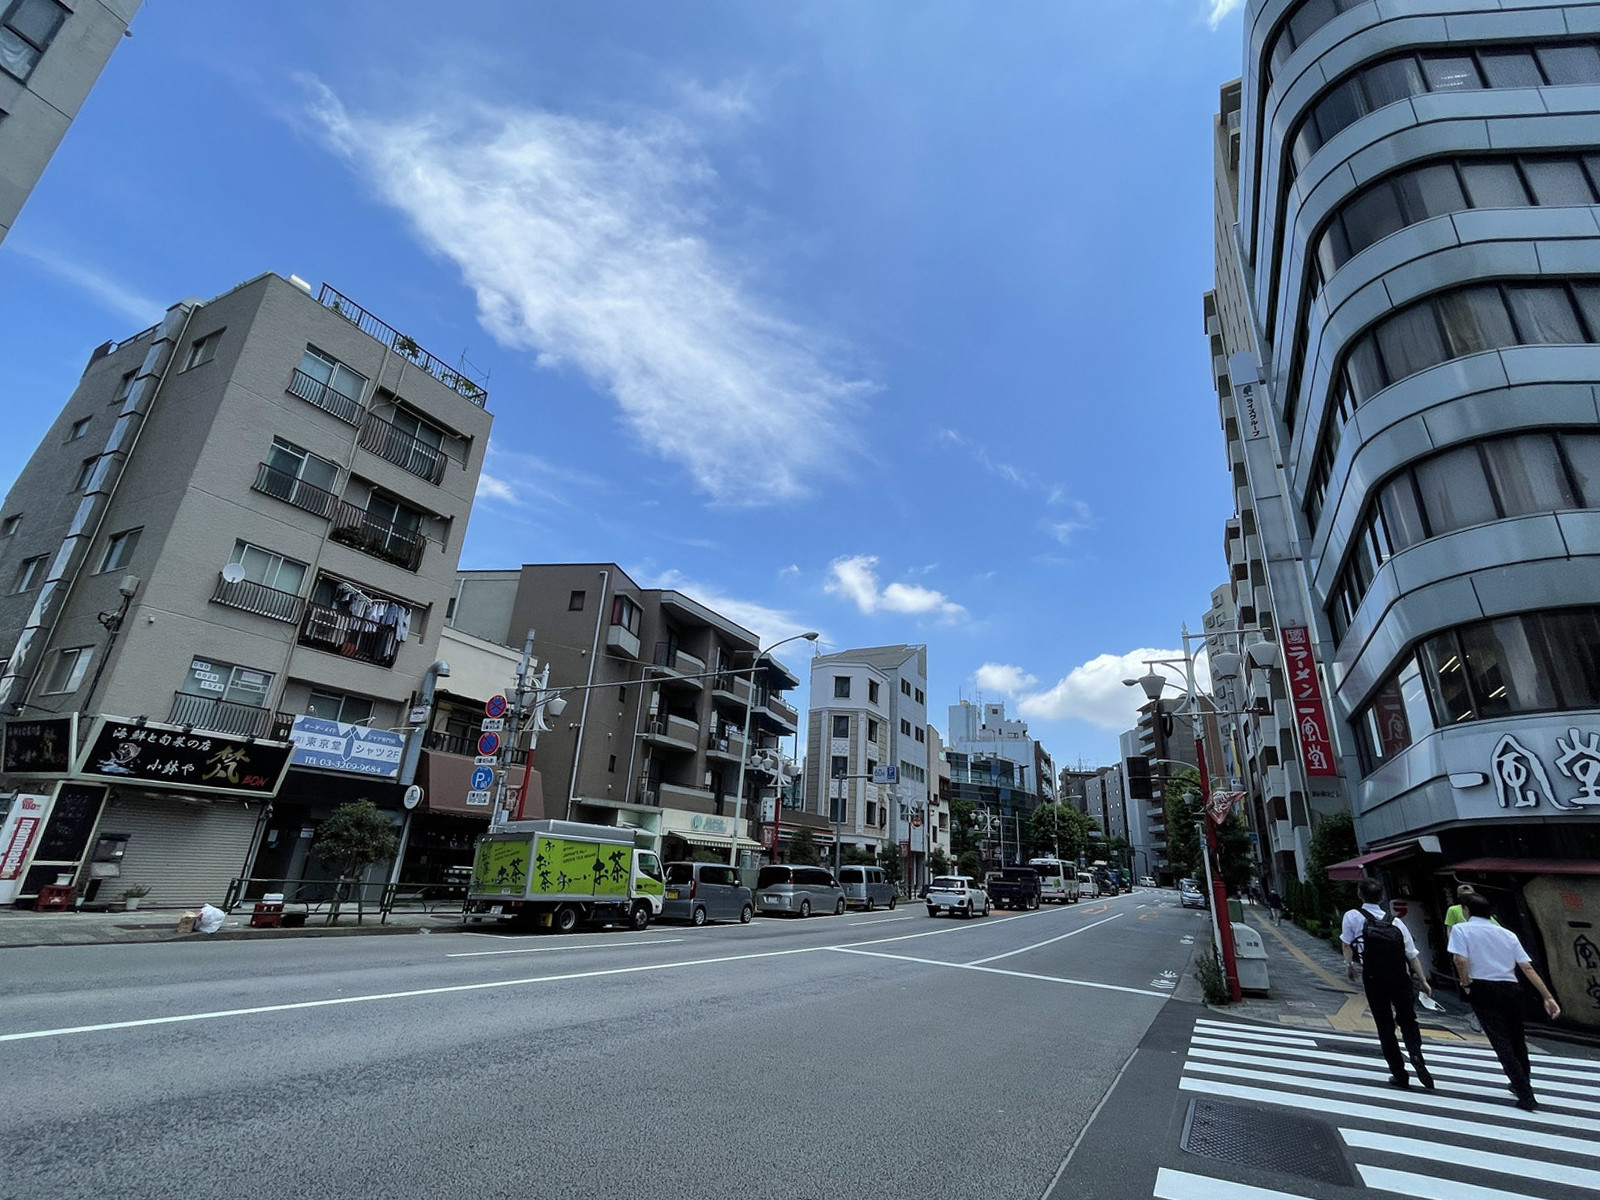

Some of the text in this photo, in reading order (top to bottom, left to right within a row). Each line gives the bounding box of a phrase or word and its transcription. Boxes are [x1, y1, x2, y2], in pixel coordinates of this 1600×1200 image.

[1288, 646, 1313, 699] ラーメン
[113, 727, 212, 751] 海鮮と旬菜の店
[1299, 707, 1330, 770] 一風堂
[146, 759, 195, 776] 小鉢や
[319, 758, 381, 774] 03-3209-9684
[1449, 727, 1600, 810] 一風堂
